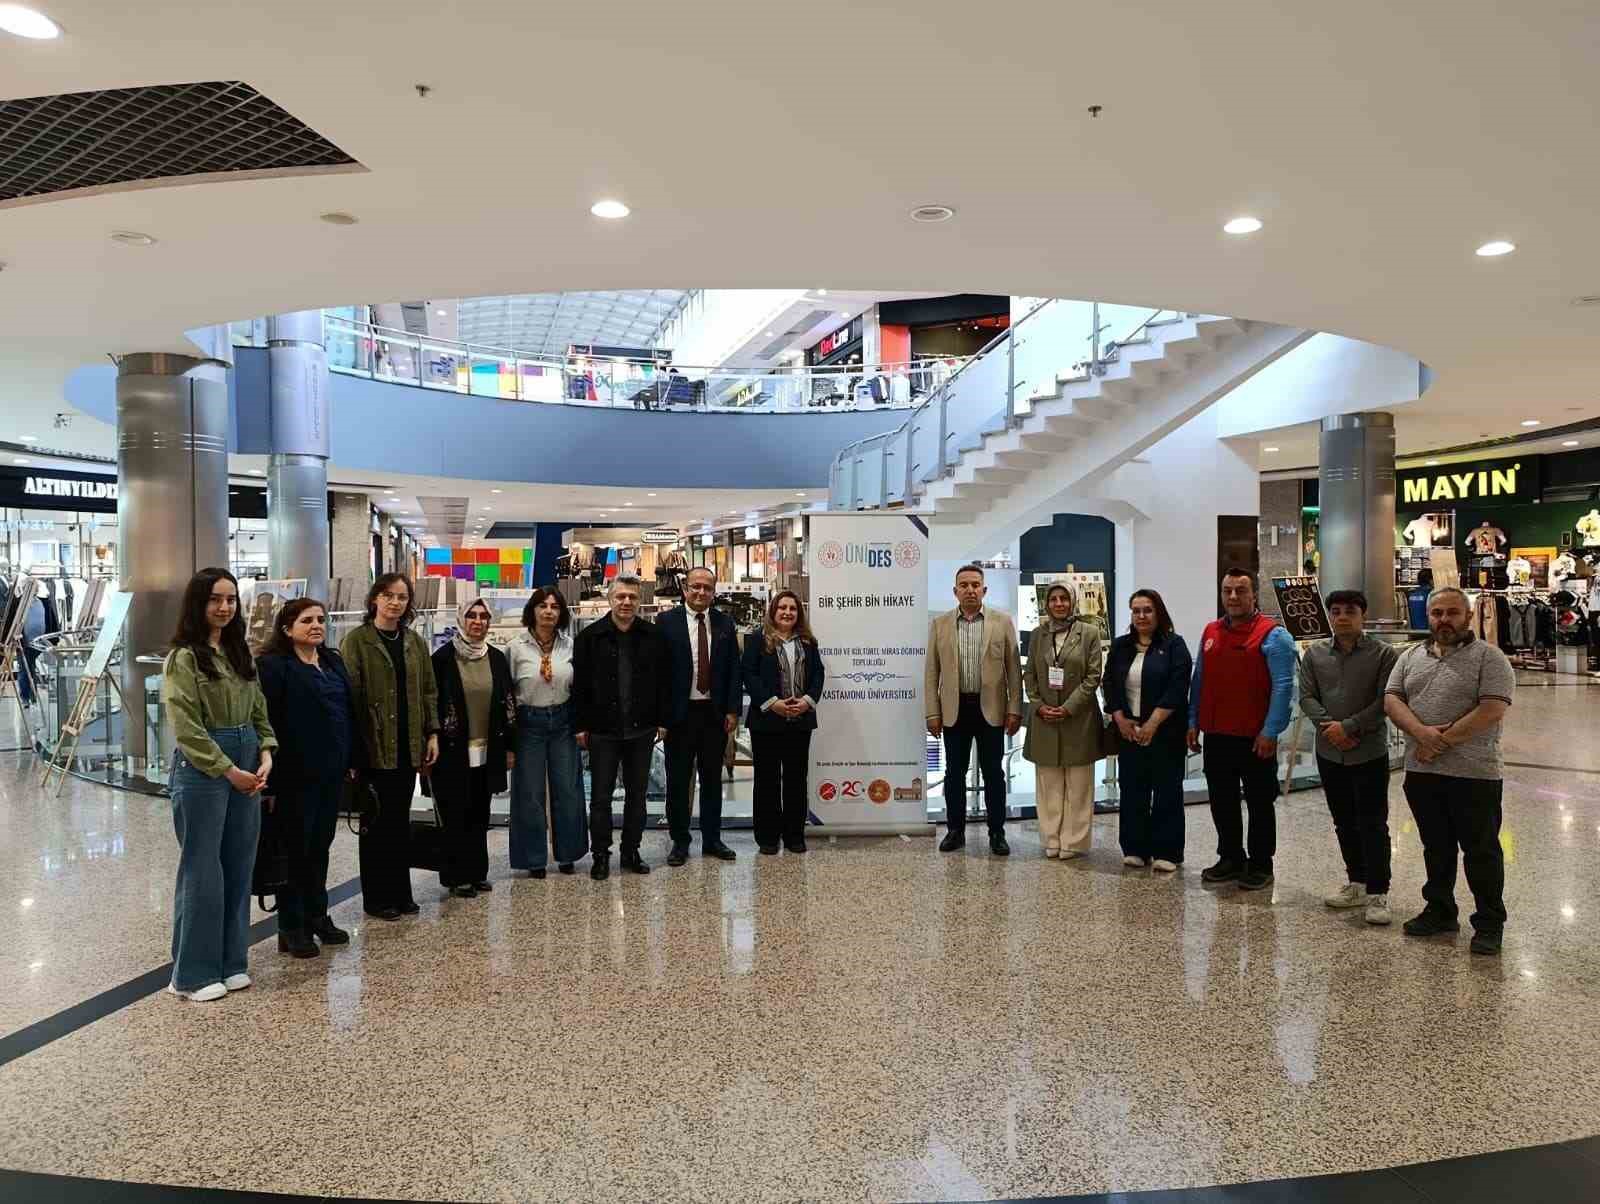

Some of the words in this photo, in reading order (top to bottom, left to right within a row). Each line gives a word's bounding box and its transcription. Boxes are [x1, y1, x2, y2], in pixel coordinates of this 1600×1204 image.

[1403, 468, 1516, 503] MAYIN
[818, 595, 834, 608] BİR
[836, 594, 863, 610] ŞEHİR
[865, 594, 880, 607] BİN
[883, 593, 914, 607] HİKAYE
[822, 689, 866, 700] KASTAMONU
